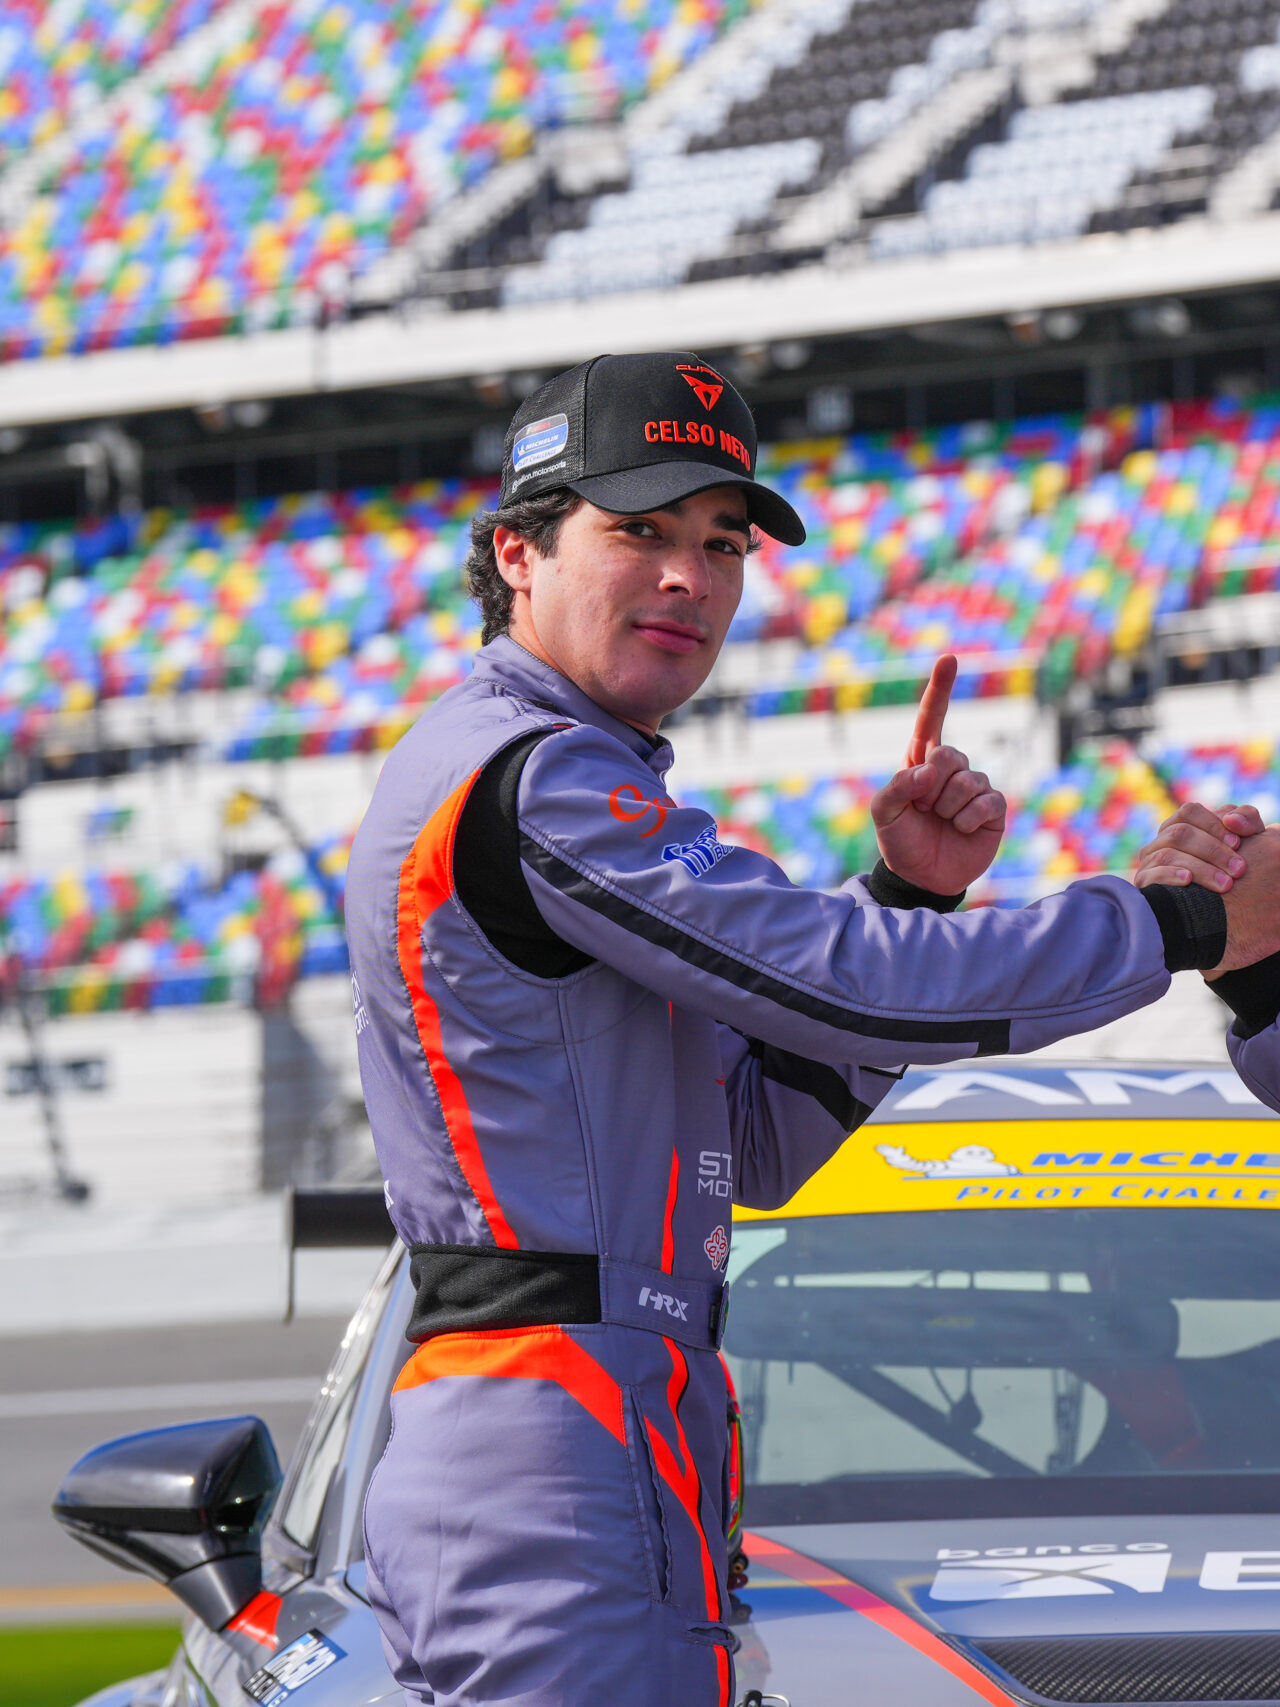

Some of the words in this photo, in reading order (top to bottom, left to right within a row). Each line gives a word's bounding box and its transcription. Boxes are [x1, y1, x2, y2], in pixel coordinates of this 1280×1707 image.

[644, 420, 715, 447] CELSO
[719, 429, 751, 472] NETO
[638, 1286, 689, 1322] HRX
[936, 1542, 1169, 1560] banco
